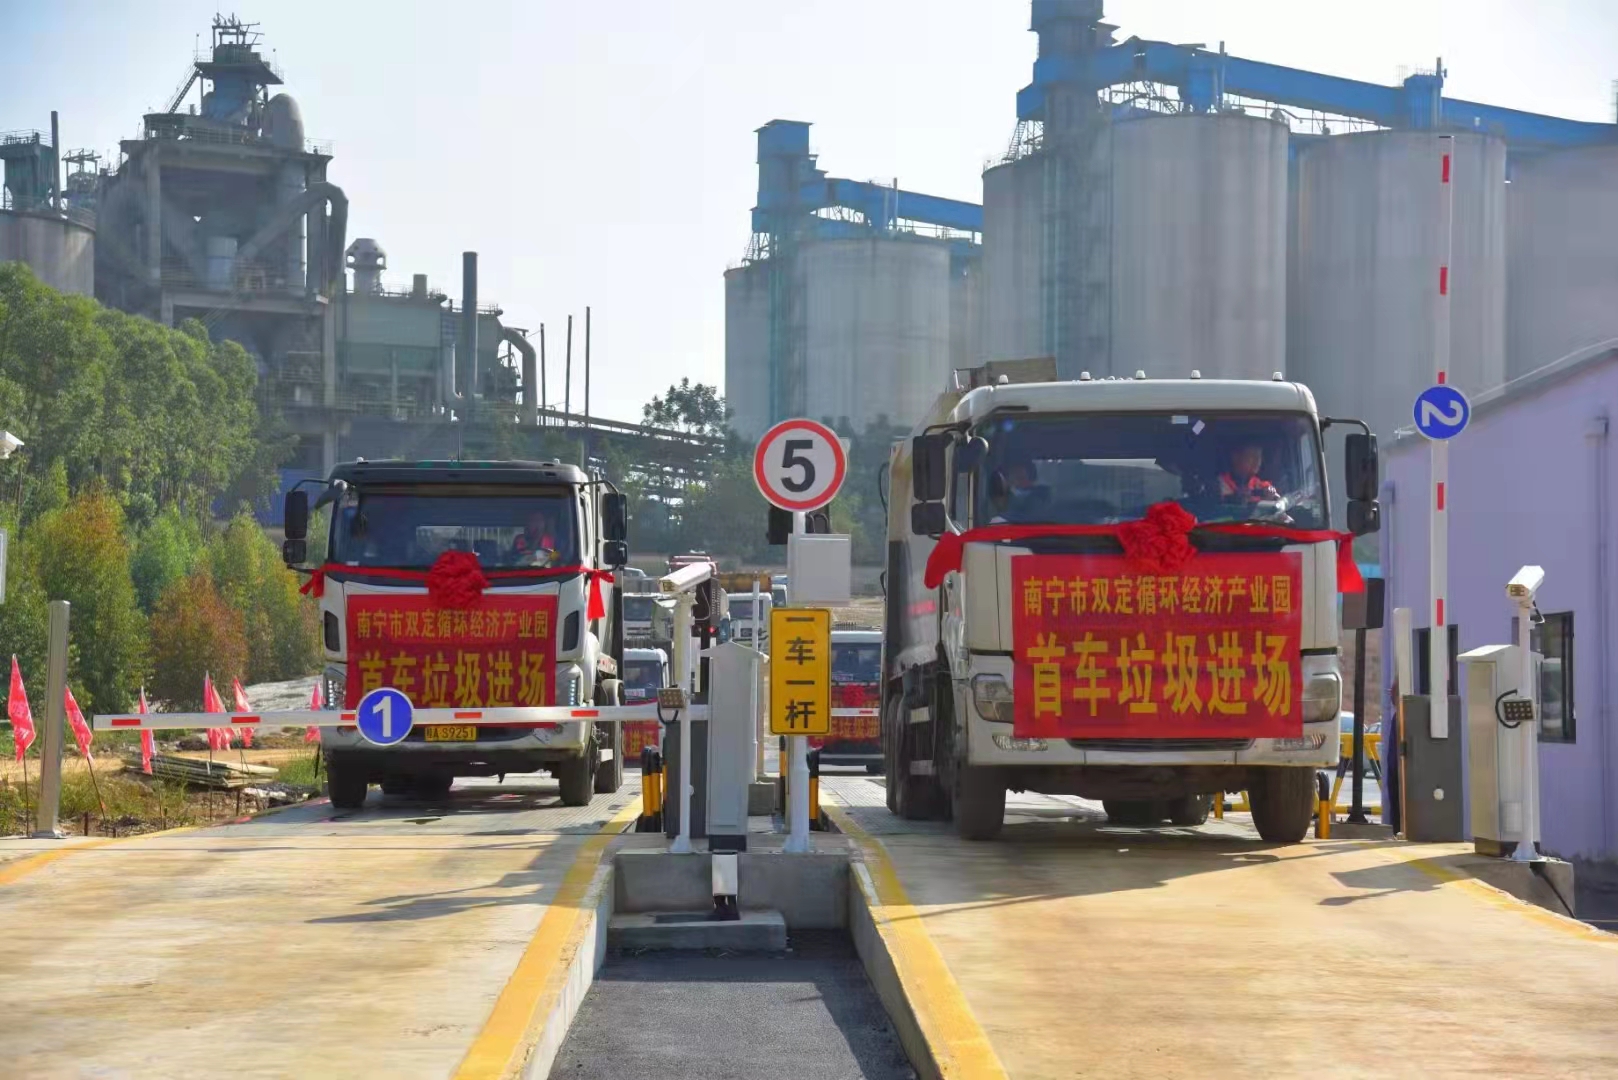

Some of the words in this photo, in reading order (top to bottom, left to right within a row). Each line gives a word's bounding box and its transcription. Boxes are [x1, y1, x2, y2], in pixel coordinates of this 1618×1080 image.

[1421, 399, 1464, 427] 2
[781, 439, 815, 493] 5
[1023, 575, 1291, 616] 南宁市双定循环经济产业园
[357, 608, 549, 639] 南宁市双定循环经济产业园
[783, 616, 816, 729] 一车一杆
[1026, 630, 1291, 718] 首车垃圾进场
[372, 695, 392, 738] 1
